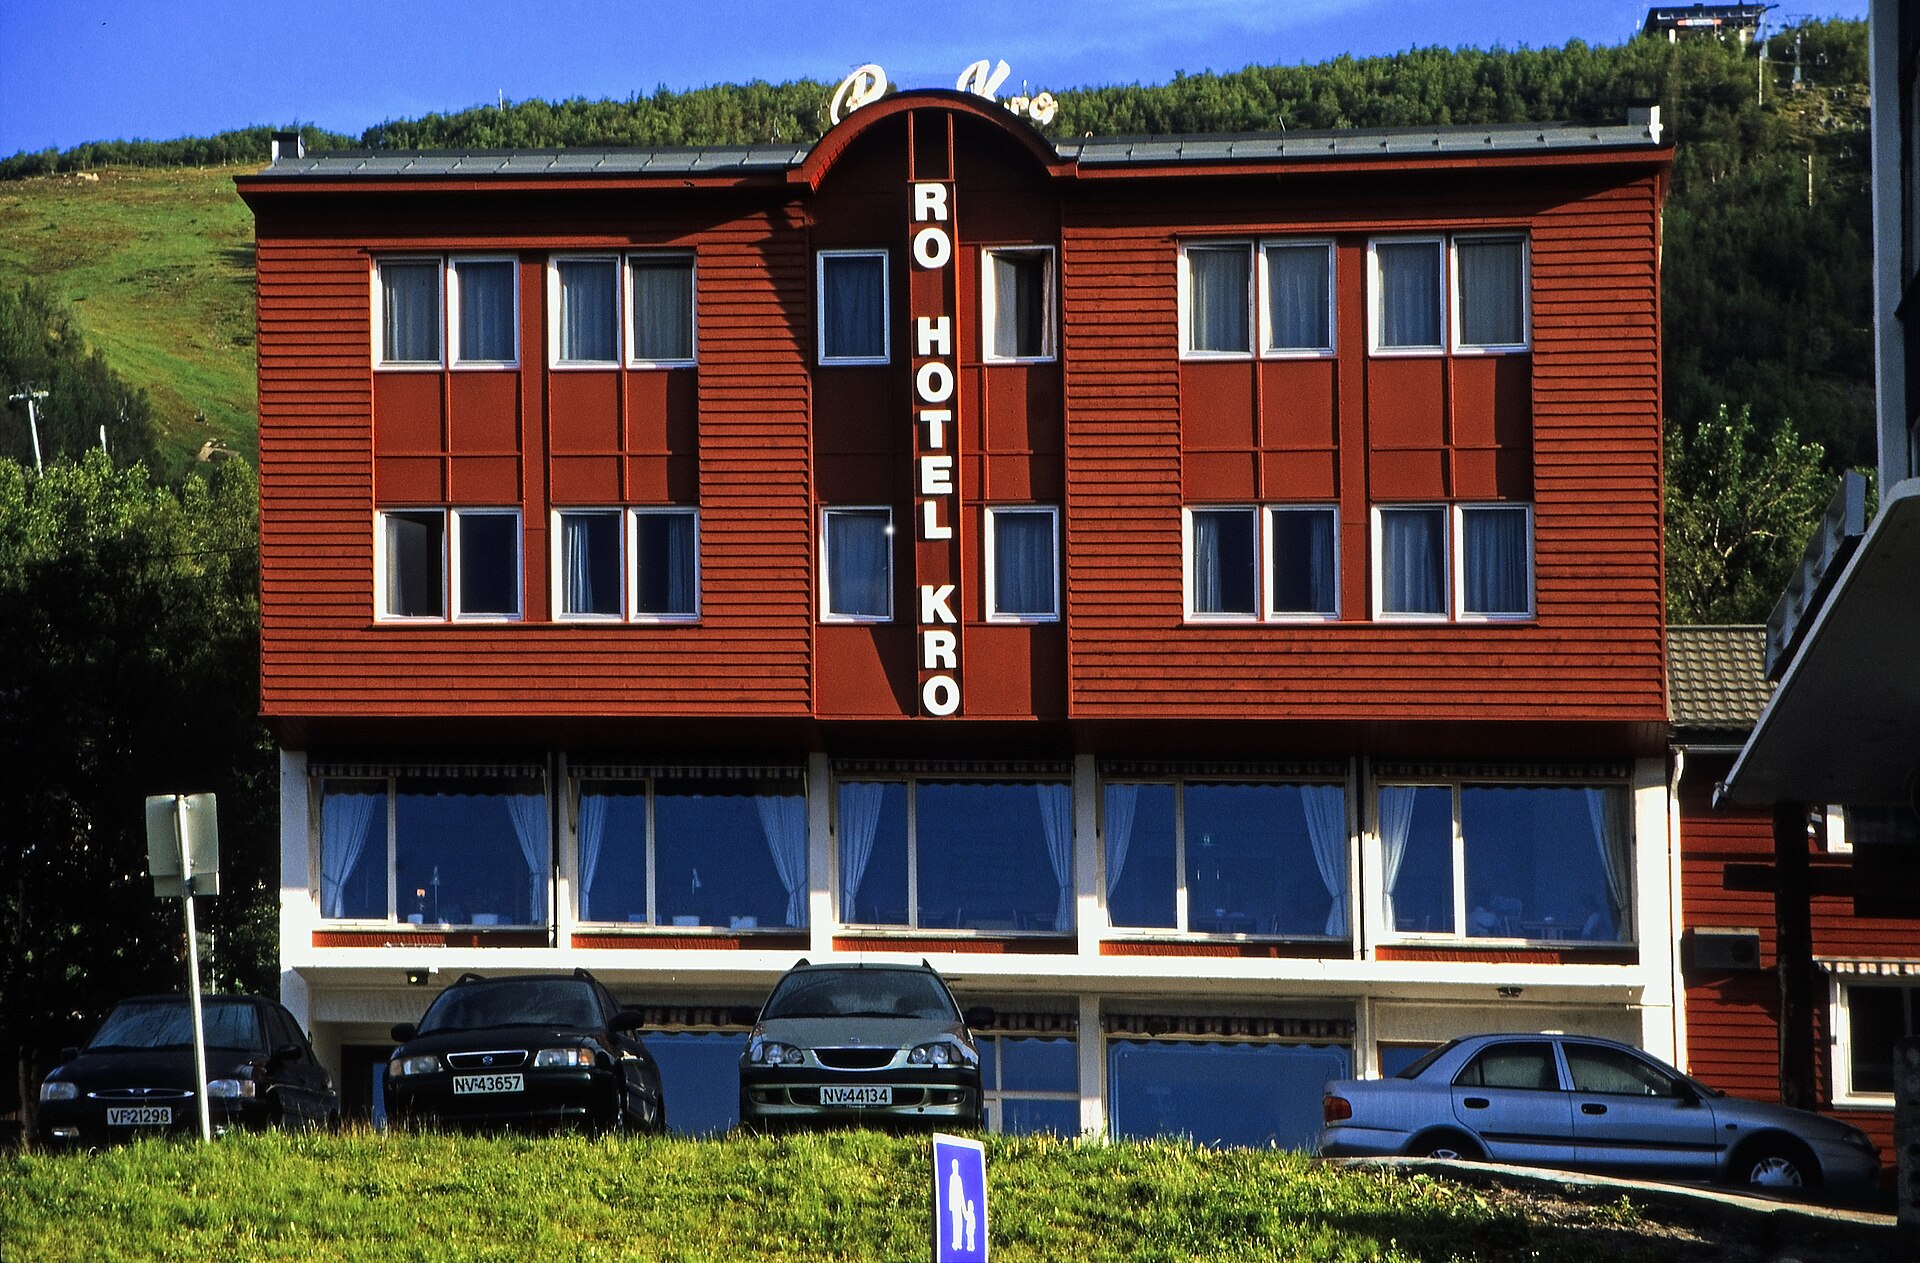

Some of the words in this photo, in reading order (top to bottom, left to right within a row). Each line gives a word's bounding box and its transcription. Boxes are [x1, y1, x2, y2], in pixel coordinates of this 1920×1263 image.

[913, 183, 951, 269] RO
[916, 316, 953, 540] HOTEL
[921, 584, 960, 716] KRO
